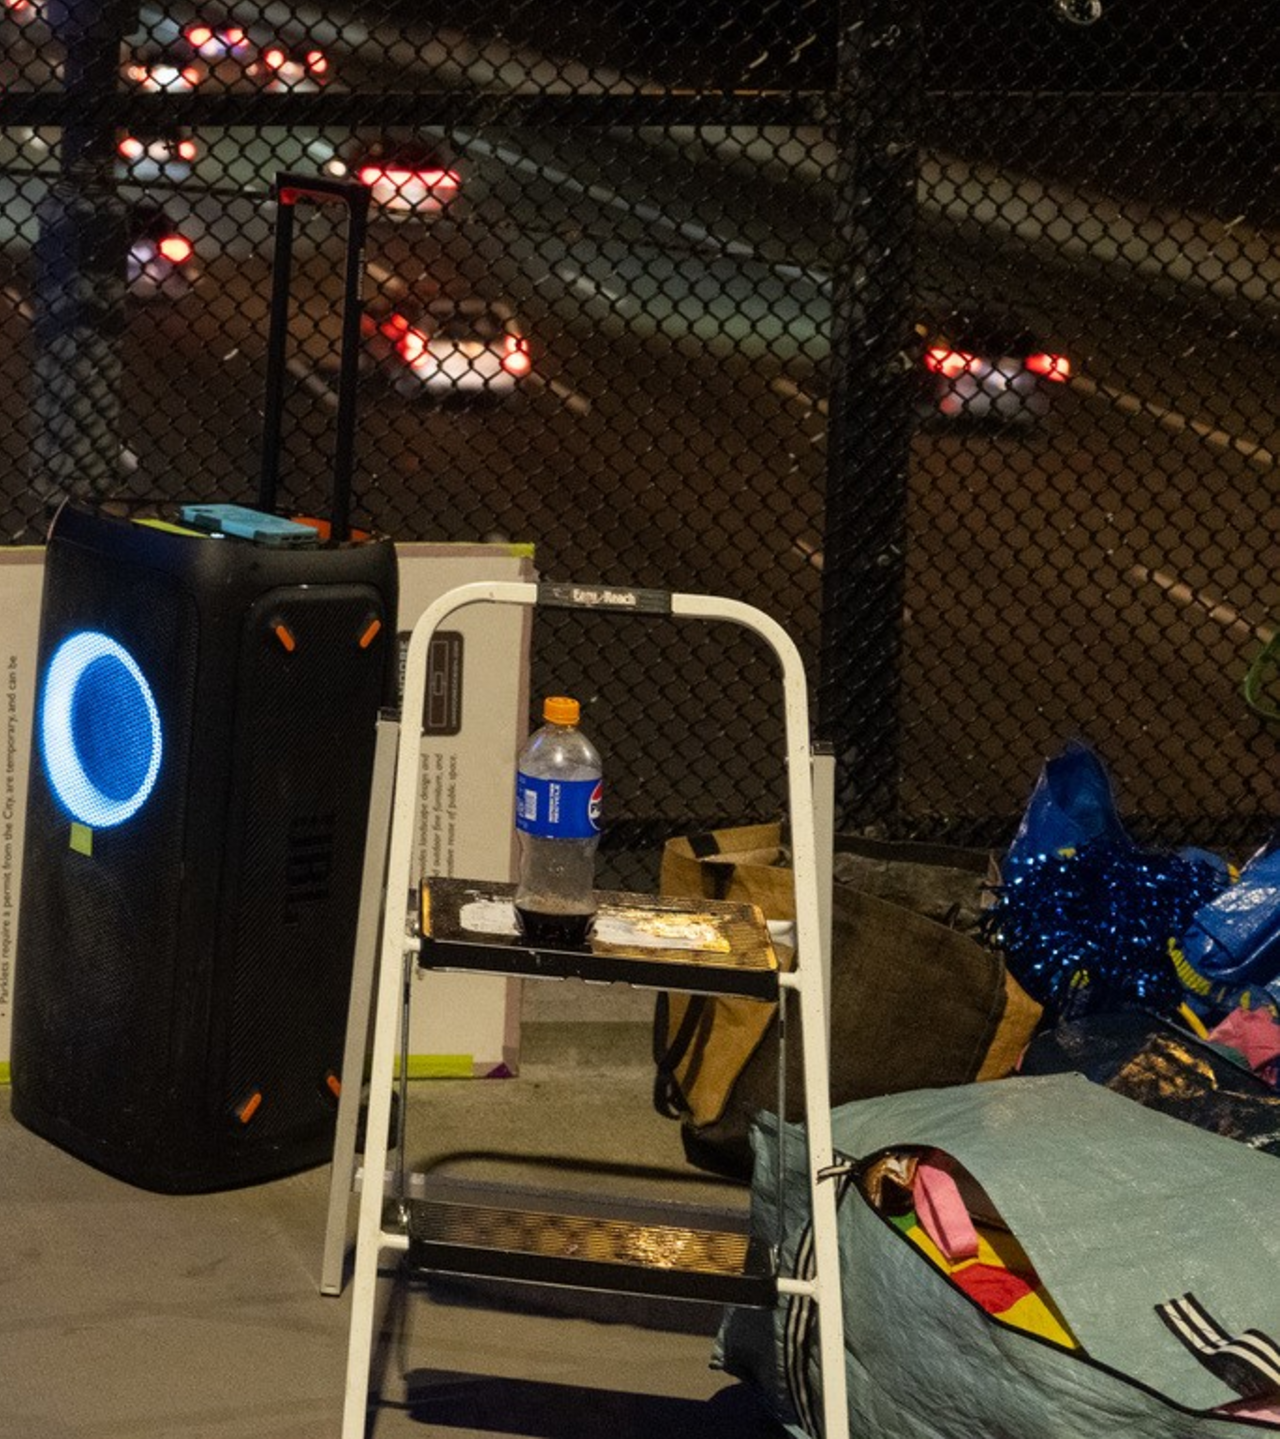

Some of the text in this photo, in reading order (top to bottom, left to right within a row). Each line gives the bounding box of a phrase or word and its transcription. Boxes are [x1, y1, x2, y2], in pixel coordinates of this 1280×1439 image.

[6, 656, 17, 669] be
[7, 672, 17, 690] can
[5, 694, 16, 712] and
[6, 776, 15, 793] are
[1, 823, 13, 841] the
[0, 844, 12, 870] from
[0, 872, 14, 908] permit
[0, 920, 13, 958] require
